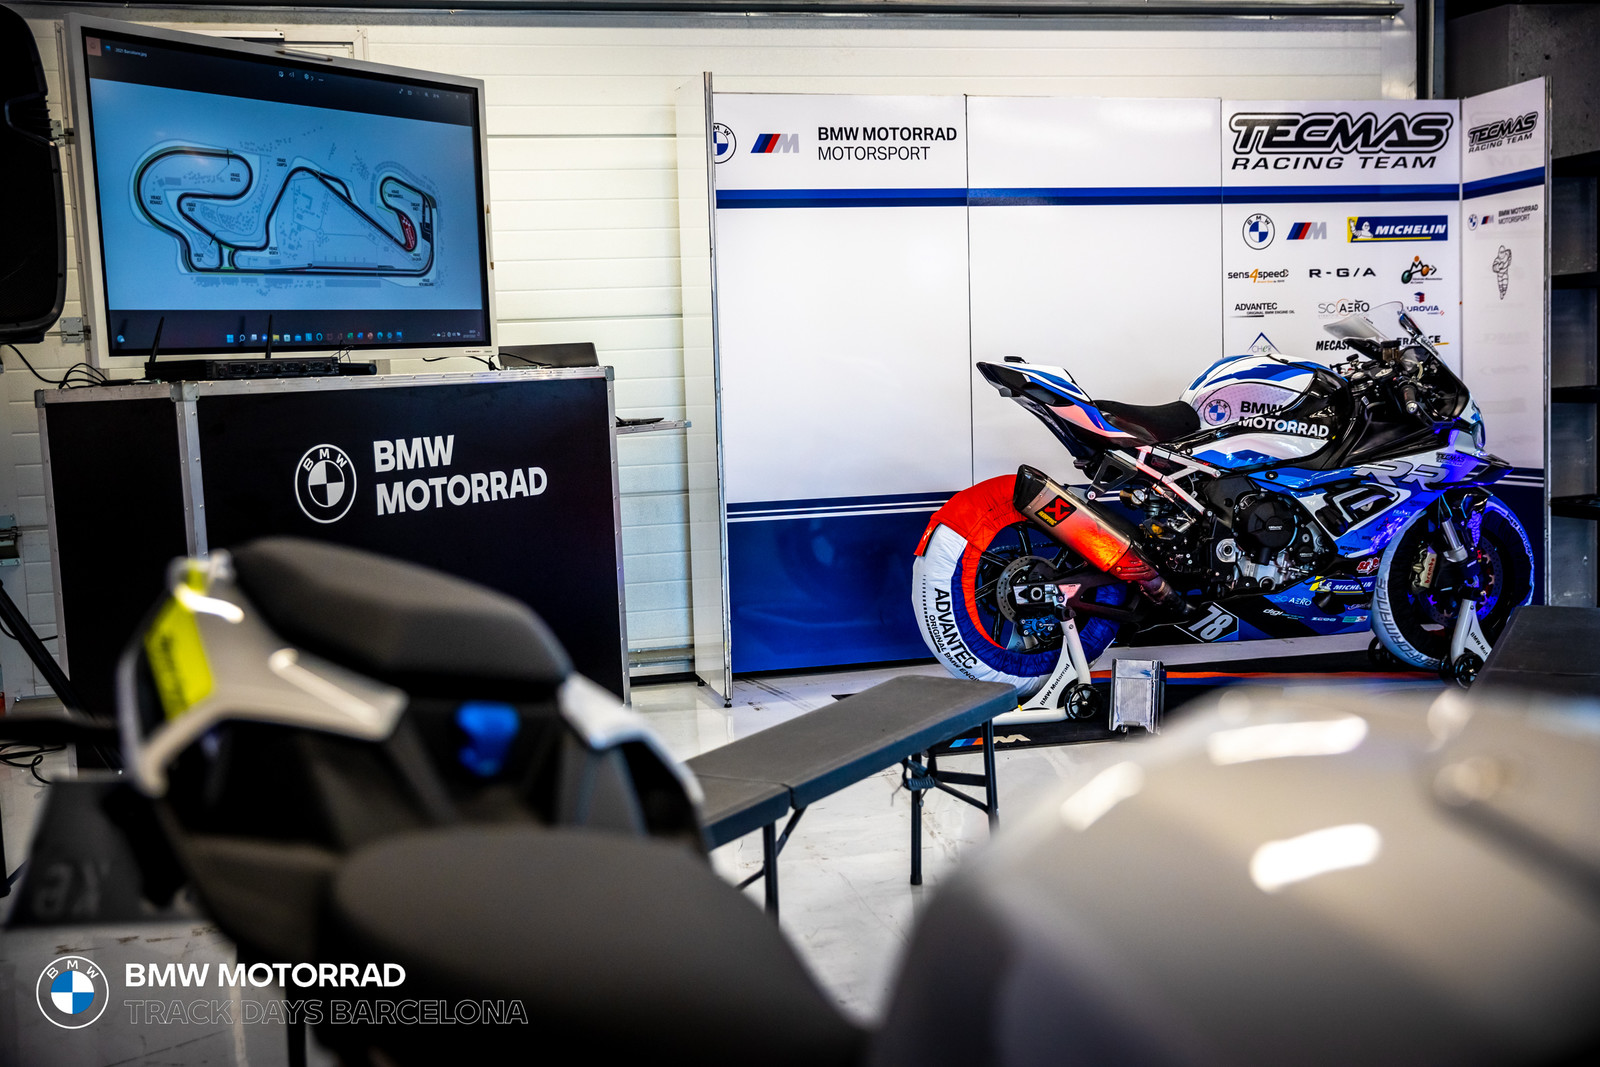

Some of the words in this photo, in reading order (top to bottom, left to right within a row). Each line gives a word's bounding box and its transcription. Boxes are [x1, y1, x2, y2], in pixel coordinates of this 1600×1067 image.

[817, 127, 860, 141] BMW
[862, 127, 958, 141] MOTORRAD
[1229, 112, 1454, 154] TECMAS
[1467, 111, 1539, 146] TECMAS
[817, 146, 931, 161] MOTORSPORT
[1468, 139, 1503, 154] RACING
[1507, 132, 1533, 145] TEAM
[1231, 156, 1345, 170] RACING
[1358, 155, 1438, 170] TEAM
[1498, 209, 1510, 217] BMW
[1510, 204, 1539, 215] MOTORRAD
[1498, 213, 1531, 225] MOTORSPORT
[1374, 224, 1447, 236] MICHELIN
[1234, 302, 1278, 311] ADVANTEC
[1315, 339, 1350, 351] MECAS
[1396, 335, 1441, 346] FRACE
[1240, 401, 1283, 416] BMW
[1237, 416, 1330, 438] MOTORRAD
[302, 448, 348, 472] BMW
[373, 434, 455, 473] BMW
[376, 466, 548, 516] MOTORRAD
[1333, 581, 1373, 591] MICHEIN
[934, 587, 977, 669] ADVANTEC
[1188, 605, 1233, 641] 78
[1375, 577, 1440, 668] ERFORMANCE
[929, 614, 947, 652] ORIGINAL
[944, 652, 961, 668] BMW
[1040, 688, 1053, 706] BMW
[1050, 663, 1071, 691] Motorrad
